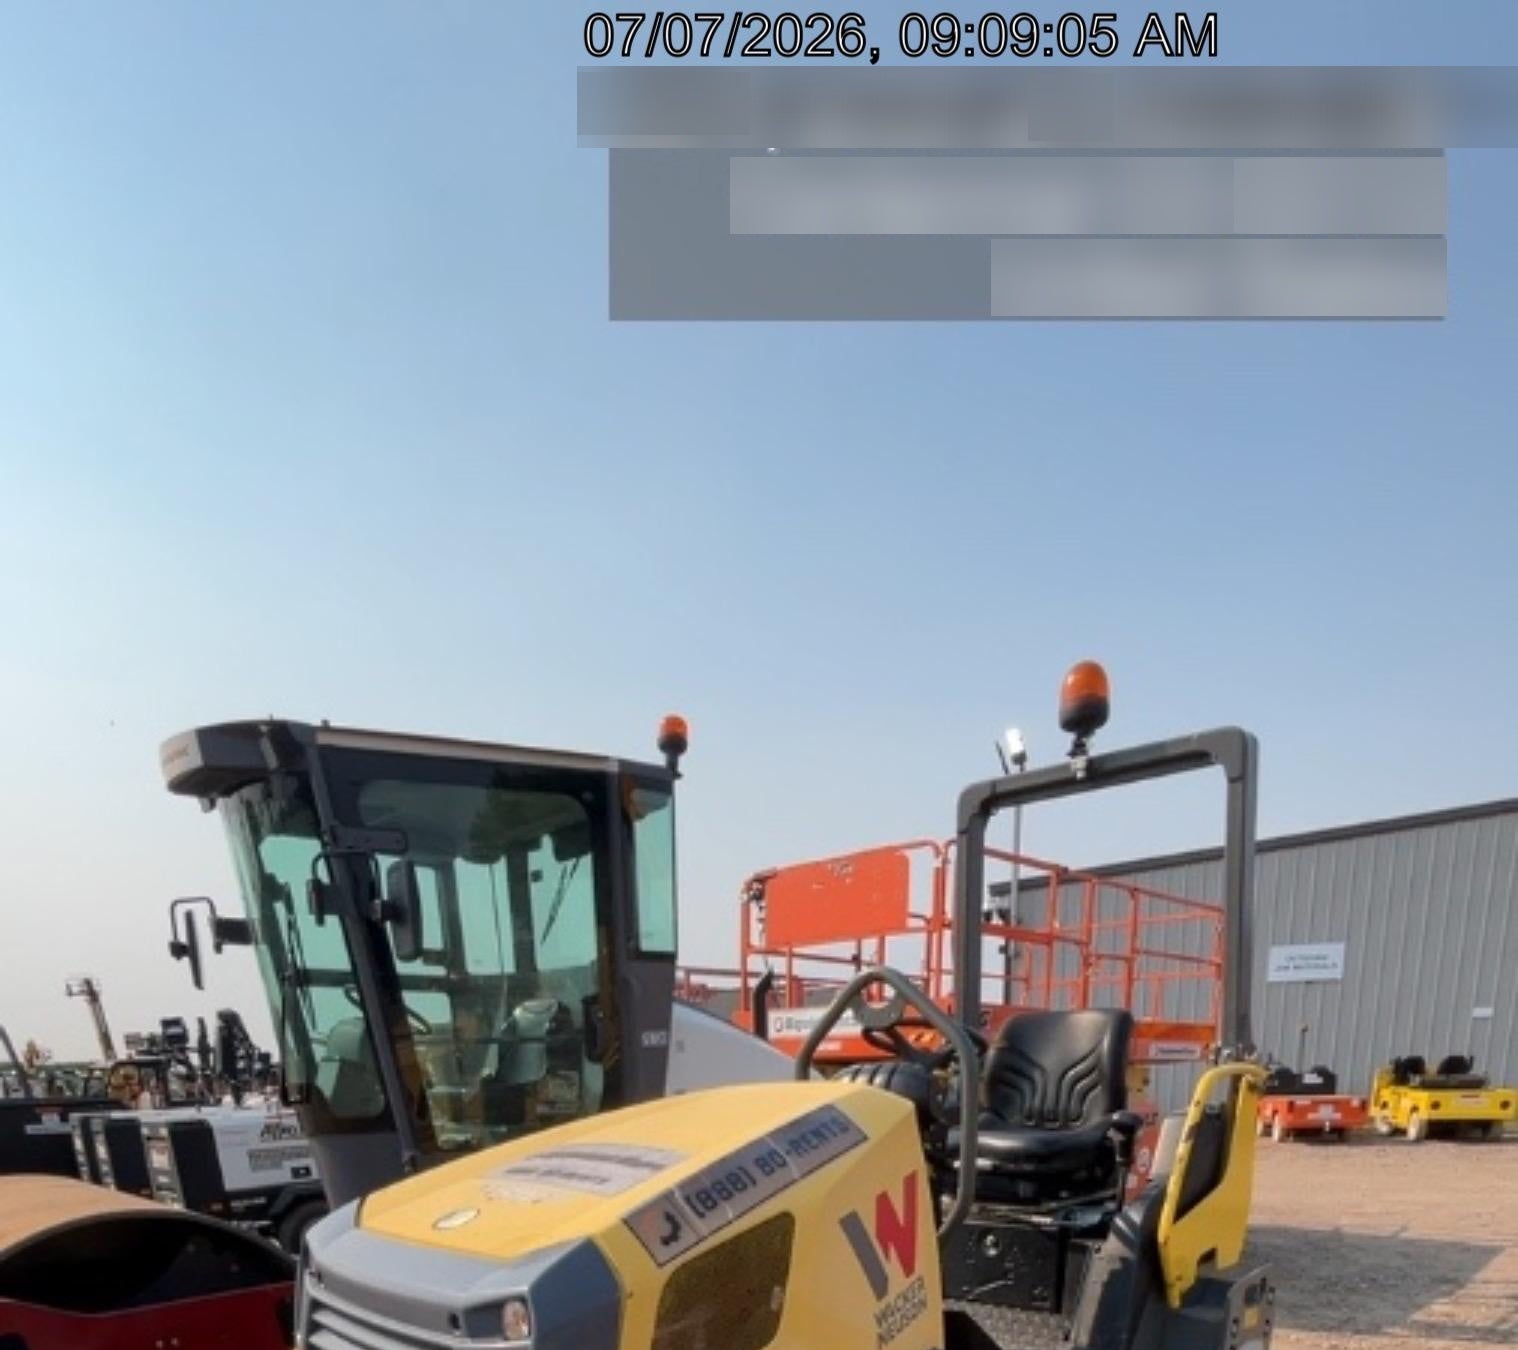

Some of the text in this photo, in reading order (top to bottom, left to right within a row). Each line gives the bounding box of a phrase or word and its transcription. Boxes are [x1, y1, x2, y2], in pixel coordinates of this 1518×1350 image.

[684, 1166, 757, 1219] (888)
[873, 1275, 925, 1327] WACKER
[877, 1294, 927, 1350] NEUSON
